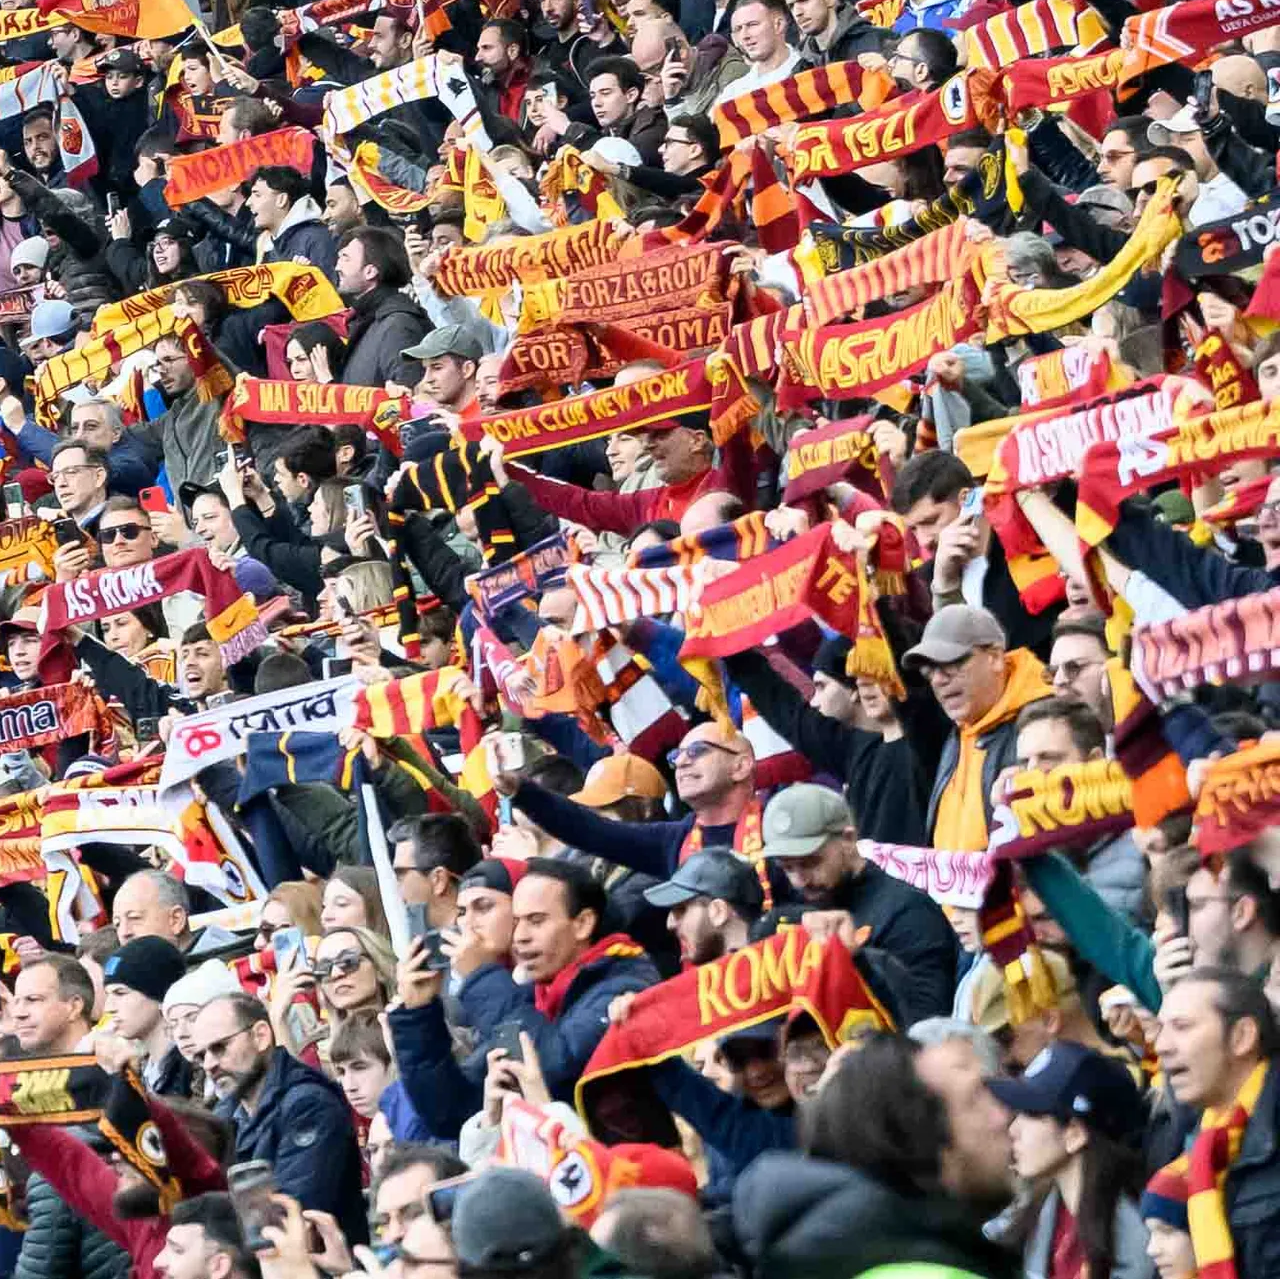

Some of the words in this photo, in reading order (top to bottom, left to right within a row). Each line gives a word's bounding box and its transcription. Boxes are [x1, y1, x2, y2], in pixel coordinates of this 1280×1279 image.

[567, 272, 640, 314] FORZA
[632, 307, 730, 352] ROMA
[258, 379, 290, 412] MAI
[296, 381, 336, 413] SOLA
[483, 409, 536, 442] ROMA
[540, 397, 587, 430] CLUB
[592, 385, 633, 419] NEW
[636, 371, 689, 410] YORK
[1119, 435, 1168, 486] AS
[818, 556, 858, 607] TE
[698, 939, 822, 1026] ROMA
